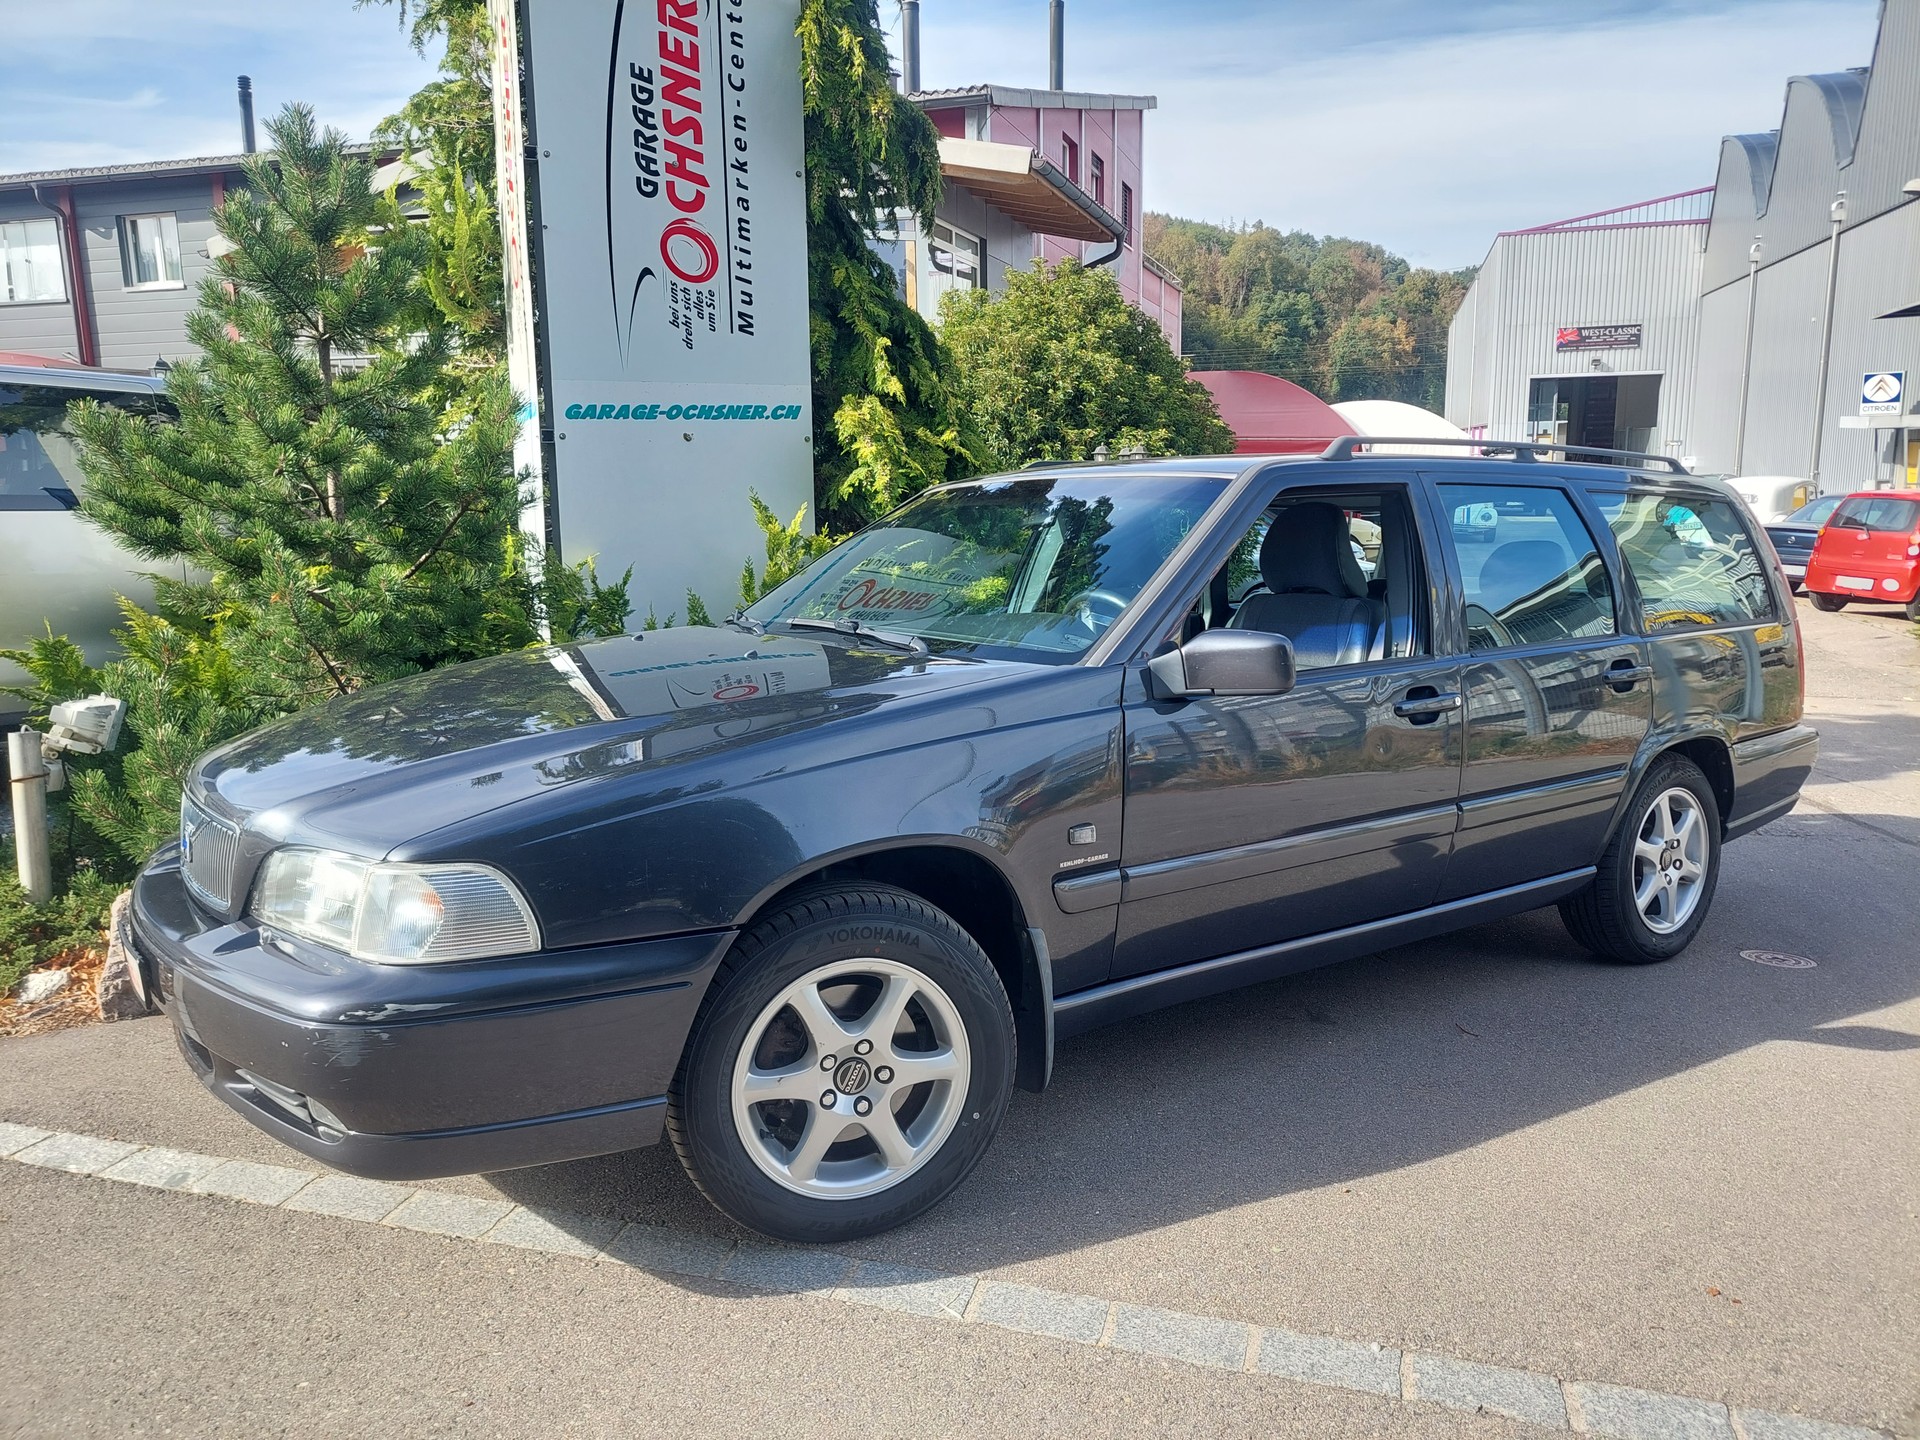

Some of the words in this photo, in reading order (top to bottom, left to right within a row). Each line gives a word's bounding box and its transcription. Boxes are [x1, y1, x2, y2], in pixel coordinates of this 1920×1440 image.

[630, 62, 661, 198] GARAGE
[657, 0, 719, 284] OCHSNER
[670, 280, 679, 304] uns
[680, 287, 691, 312] sich
[705, 289, 716, 310] Sie
[693, 289, 704, 320] alles
[669, 305, 680, 329] bei
[708, 312, 716, 332] um
[681, 314, 693, 350] dreht
[1581, 326, 1641, 337] WEST-CLASSIC
[564, 403, 802, 420] GARAGE-OCHSNER.CH
[1640, 772, 1671, 809] YOKOHAMA
[1059, 853, 1109, 868] KEHLHOF-GARAGE
[827, 926, 920, 949] YOKOHAMA
[844, 1063, 863, 1093] VOLVO
